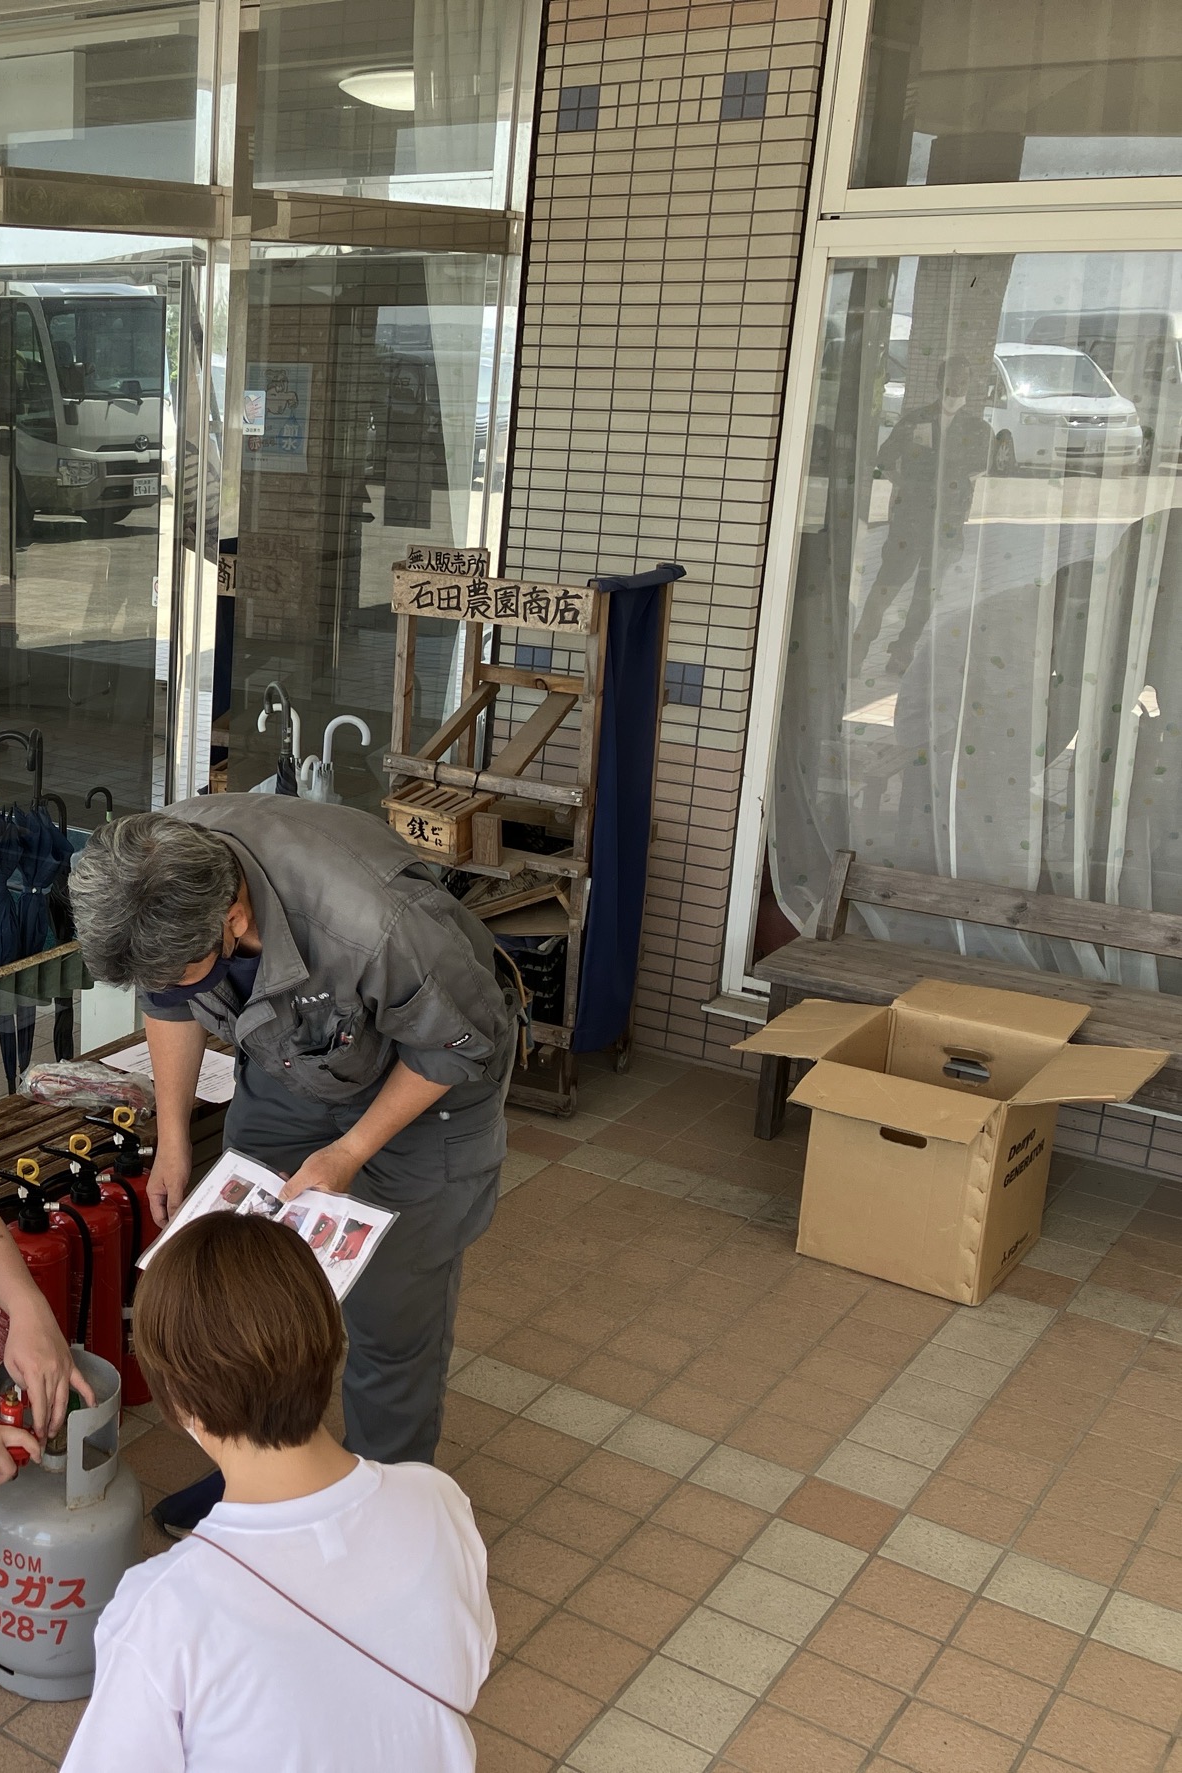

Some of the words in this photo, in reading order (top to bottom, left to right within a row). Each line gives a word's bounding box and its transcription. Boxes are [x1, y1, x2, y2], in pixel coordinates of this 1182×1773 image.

[407, 548, 488, 578] 無人販売所
[408, 577, 584, 627] 石田農園商店
[407, 816, 430, 842] 銭
[1002, 1137, 1046, 1189] GENERATOR
[1006, 1127, 1037, 1163] Denyo
